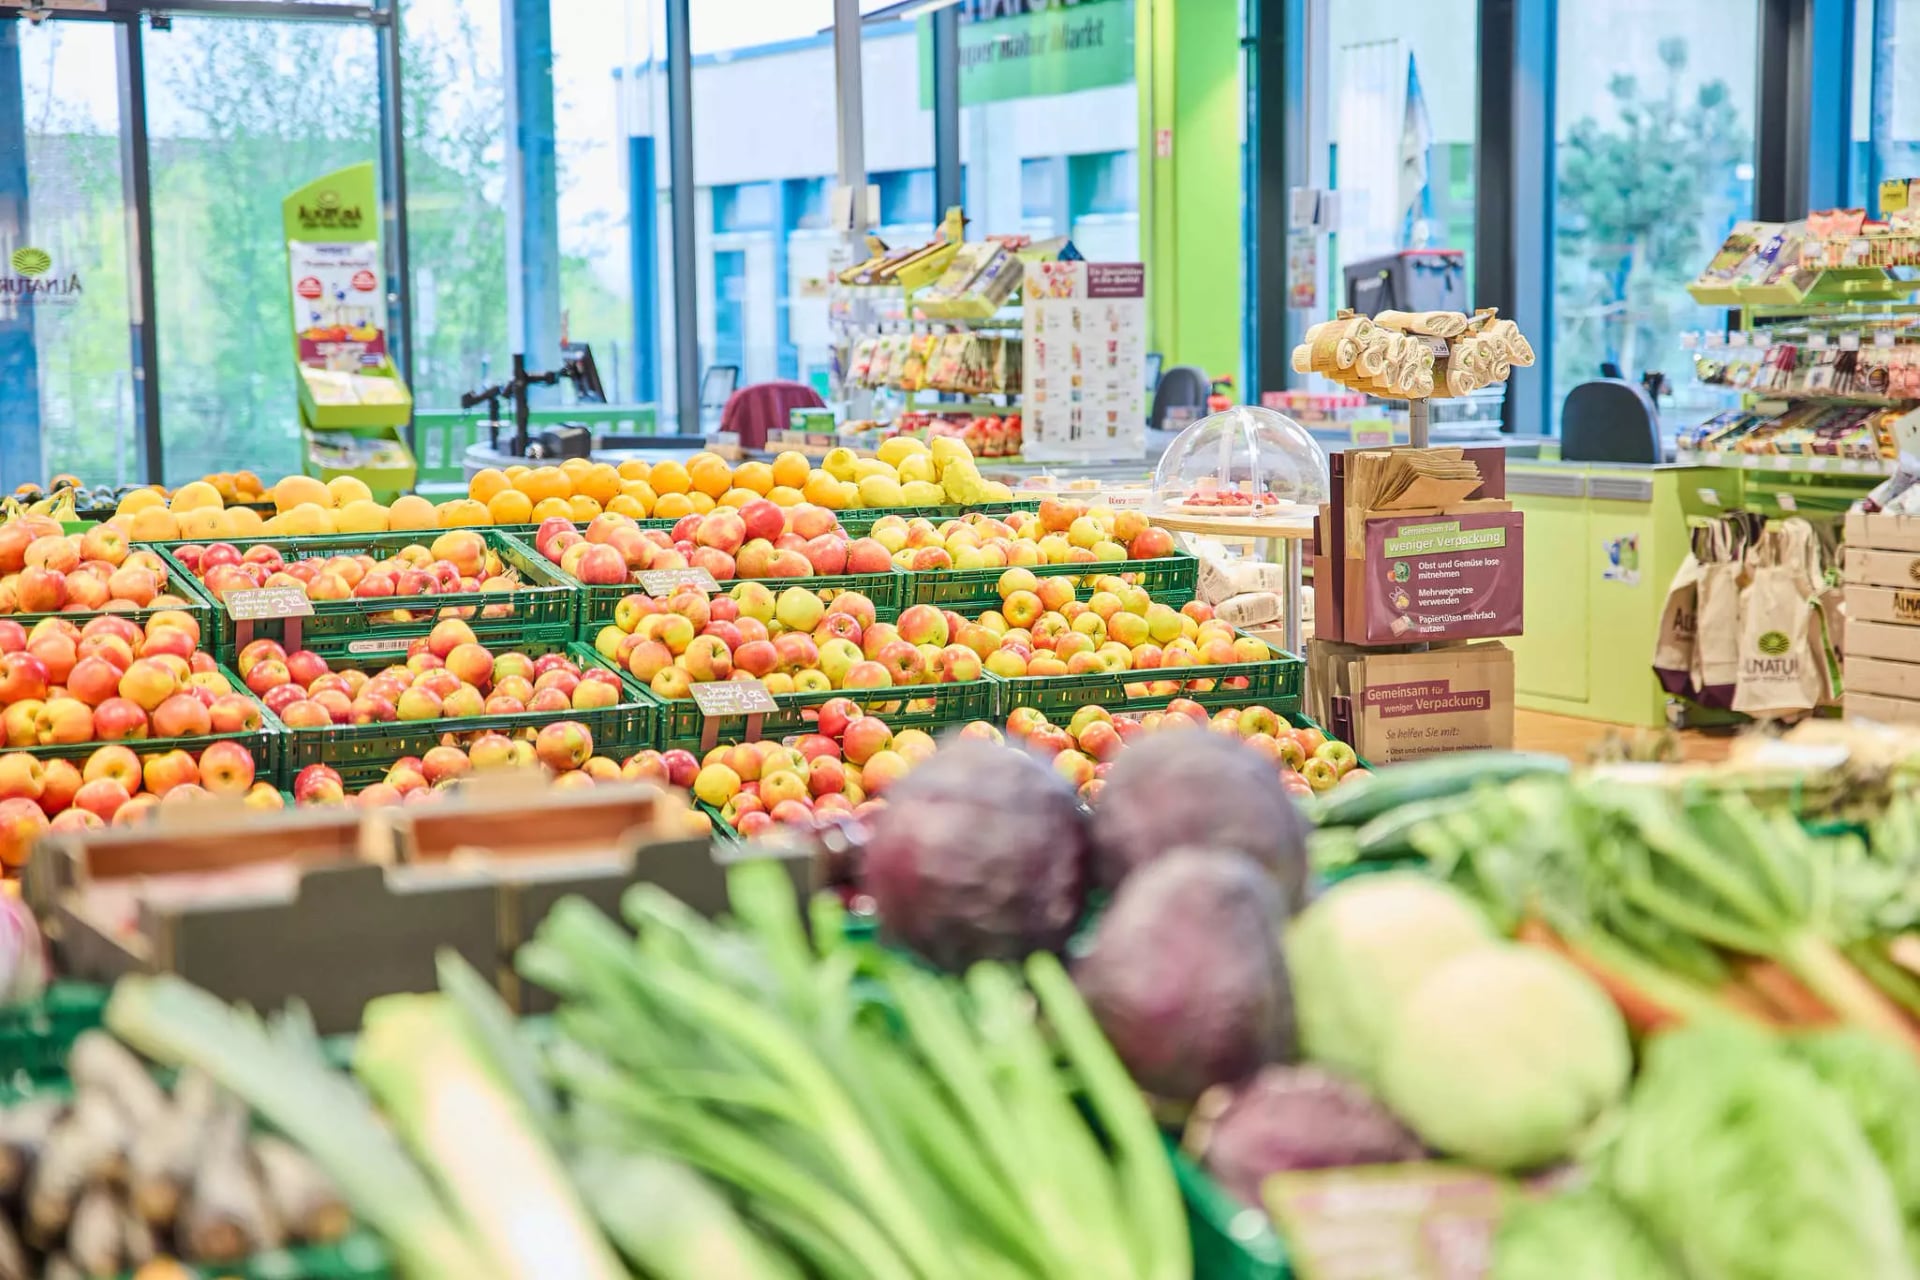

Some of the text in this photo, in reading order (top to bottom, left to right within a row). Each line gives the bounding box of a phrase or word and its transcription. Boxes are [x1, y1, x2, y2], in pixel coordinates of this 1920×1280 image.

[1401, 523, 1456, 536] Gemeinsam für
[1389, 532, 1501, 552] weniger Verpackung
[1418, 557, 1500, 570] Obst und Gemüse lose
[1418, 570, 1460, 580] mitnehmen
[1418, 586, 1474, 598] Mehrwegnetze
[1418, 597, 1460, 607] verwenden
[1419, 610, 1496, 625] Papiertüten mehrfach
[1419, 624, 1446, 634] nutzen
[1367, 686, 1445, 701] Gemeinsam für
[1384, 695, 1484, 715] weniger Verpackung
[1386, 727, 1461, 740] So helfen Sie mit:
